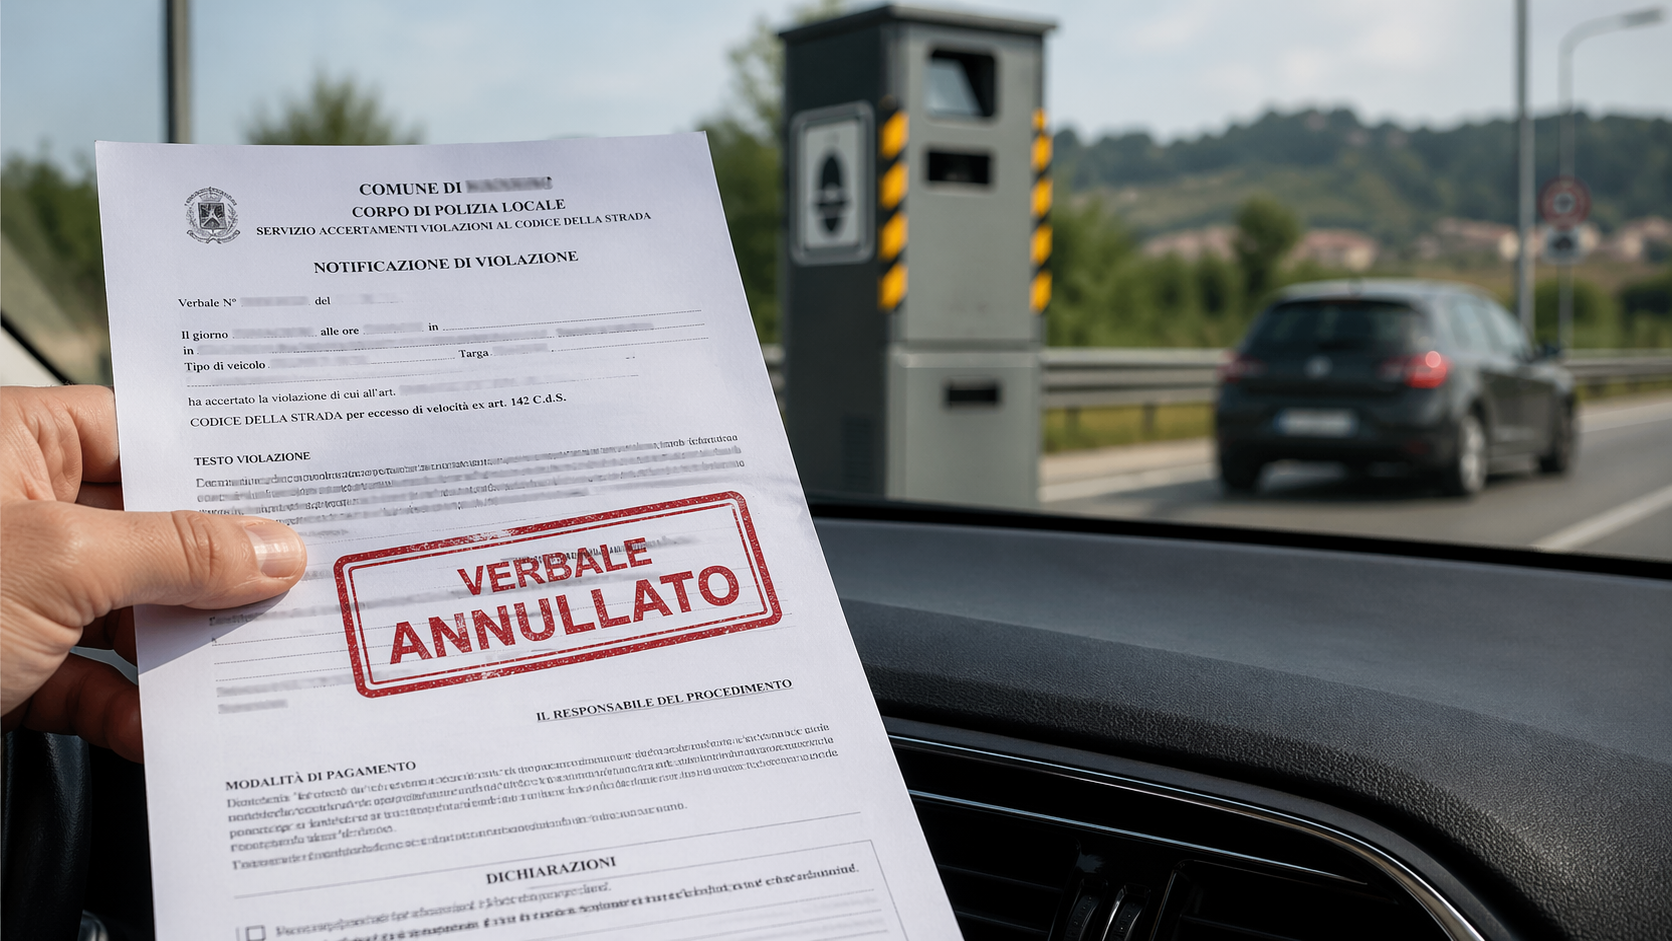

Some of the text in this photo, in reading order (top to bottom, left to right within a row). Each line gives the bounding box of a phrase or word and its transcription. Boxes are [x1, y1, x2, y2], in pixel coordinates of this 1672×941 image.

[360, 182, 438, 195] COMUNE
[444, 182, 462, 194] DI
[352, 199, 566, 217] CORPO DI POLIZIA LOCALE
[256, 212, 651, 235] SERVIZIO ACCERTAMENTI VIOLAZIONI AL CODICE DELLA STRADA
[314, 251, 578, 274] NOTIFICAZIONE DI VIOLAZIONE
[178, 298, 219, 307] Verbale
[223, 298, 237, 307] N°
[315, 297, 331, 305] del
[182, 331, 189, 339] Il
[193, 331, 228, 341] giorno
[320, 328, 339, 336] alle
[429, 323, 438, 331] in
[183, 346, 194, 355] in
[185, 362, 210, 373] Tipo
[213, 362, 224, 370] di
[227, 361, 265, 370] veicolo
[458, 350, 489, 359] Targa
[188, 388, 396, 406] ha accertato la violazione di cui all'art.
[190, 417, 241, 427] CODICE
[245, 415, 288, 425] DELLA
[291, 412, 342, 422] STRADA
[346, 412, 364, 422] per
[368, 407, 409, 418] eccesso
[412, 406, 423, 415] di
[427, 403, 468, 414] velocità
[488, 400, 507, 409] art.
[511, 396, 529, 406] 142
[533, 393, 566, 404] C.d.S.
[194, 452, 311, 466] TESTO VIOLAZIONE
[457, 537, 653, 596] VERBALE
[390, 564, 739, 664] ANNULLATO
[536, 679, 792, 722] IL RESPONSABILE DEL PROCEDIMENTO
[226, 760, 416, 791] MODALITÀ DI PAGAMENTO
[486, 856, 616, 884] DICHIARAZIONI
